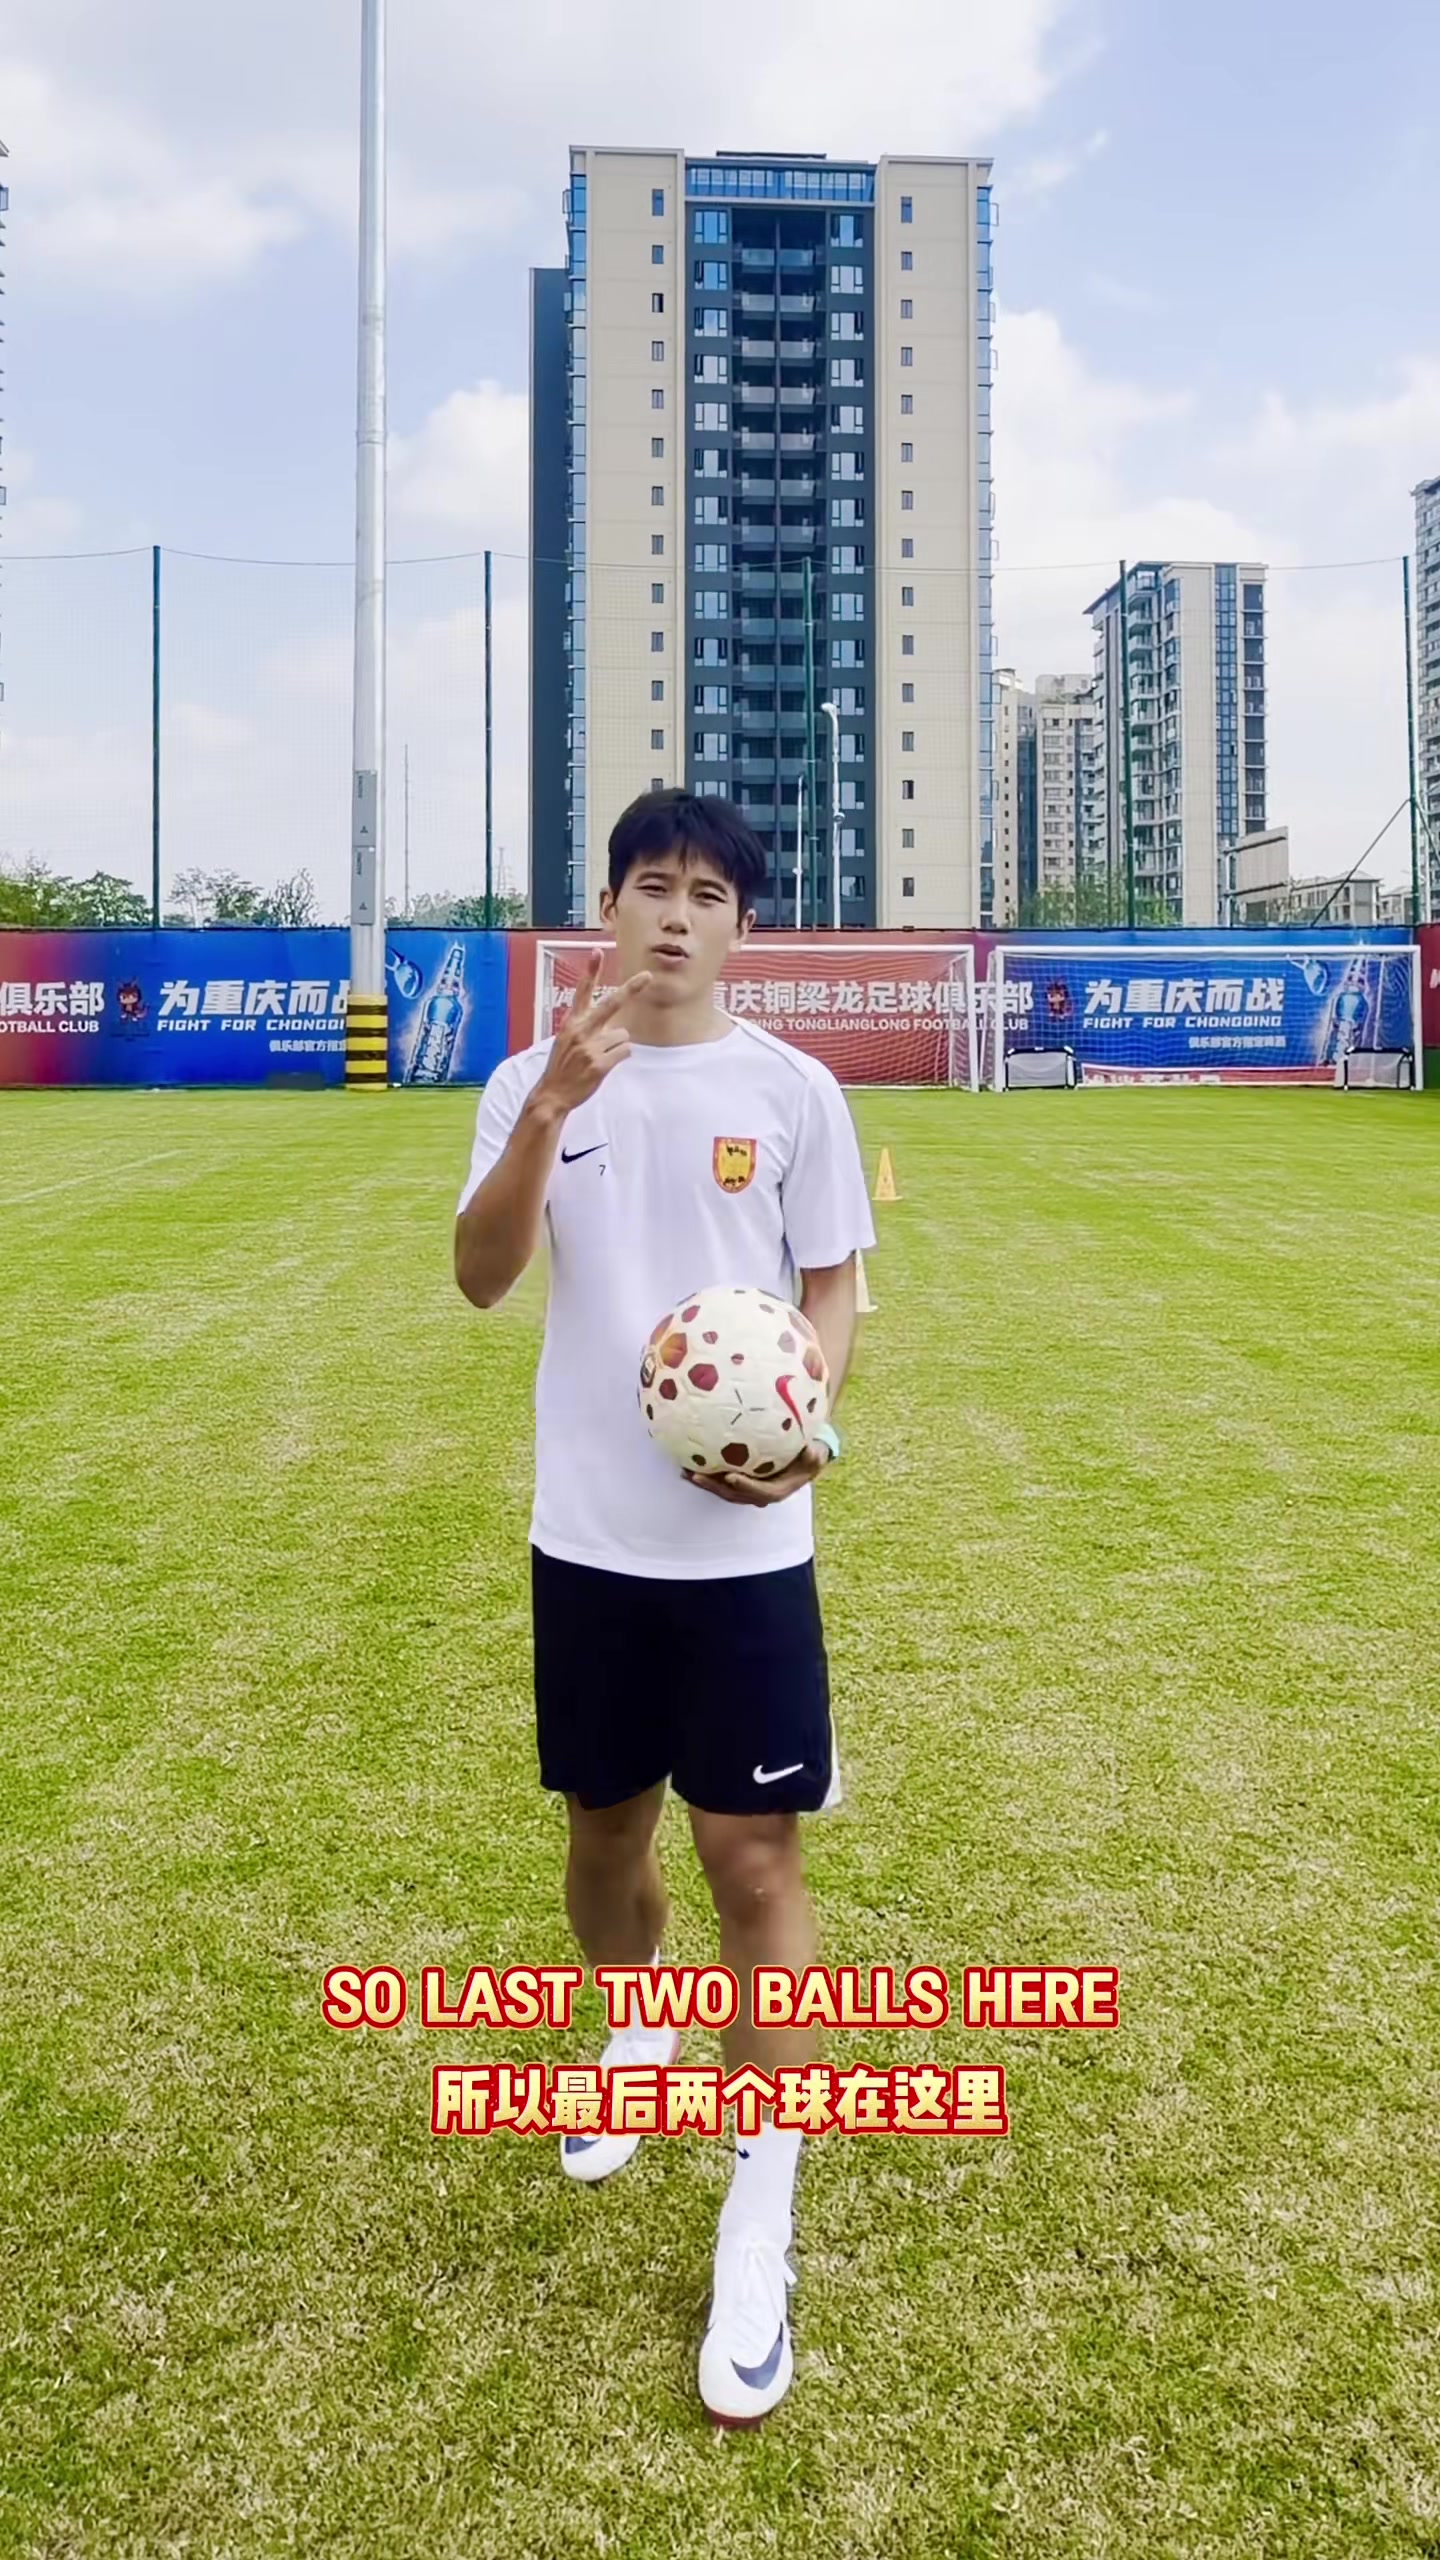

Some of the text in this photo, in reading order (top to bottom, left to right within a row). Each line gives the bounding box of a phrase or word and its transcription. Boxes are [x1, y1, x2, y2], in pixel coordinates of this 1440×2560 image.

[0, 981, 105, 1016] 俱乐部
[1084, 978, 1285, 1014] 为重庆而战
[59, 1020, 100, 1033] CLUB
[157, 1019, 211, 1032] FIGHT
[221, 1019, 257, 1032] FOR
[786, 1018, 911, 1031] TONGLIANGLONG
[1083, 1015, 1282, 1029] FIGHT FOR CHONGQING
[599, 1164, 606, 1176] 7
